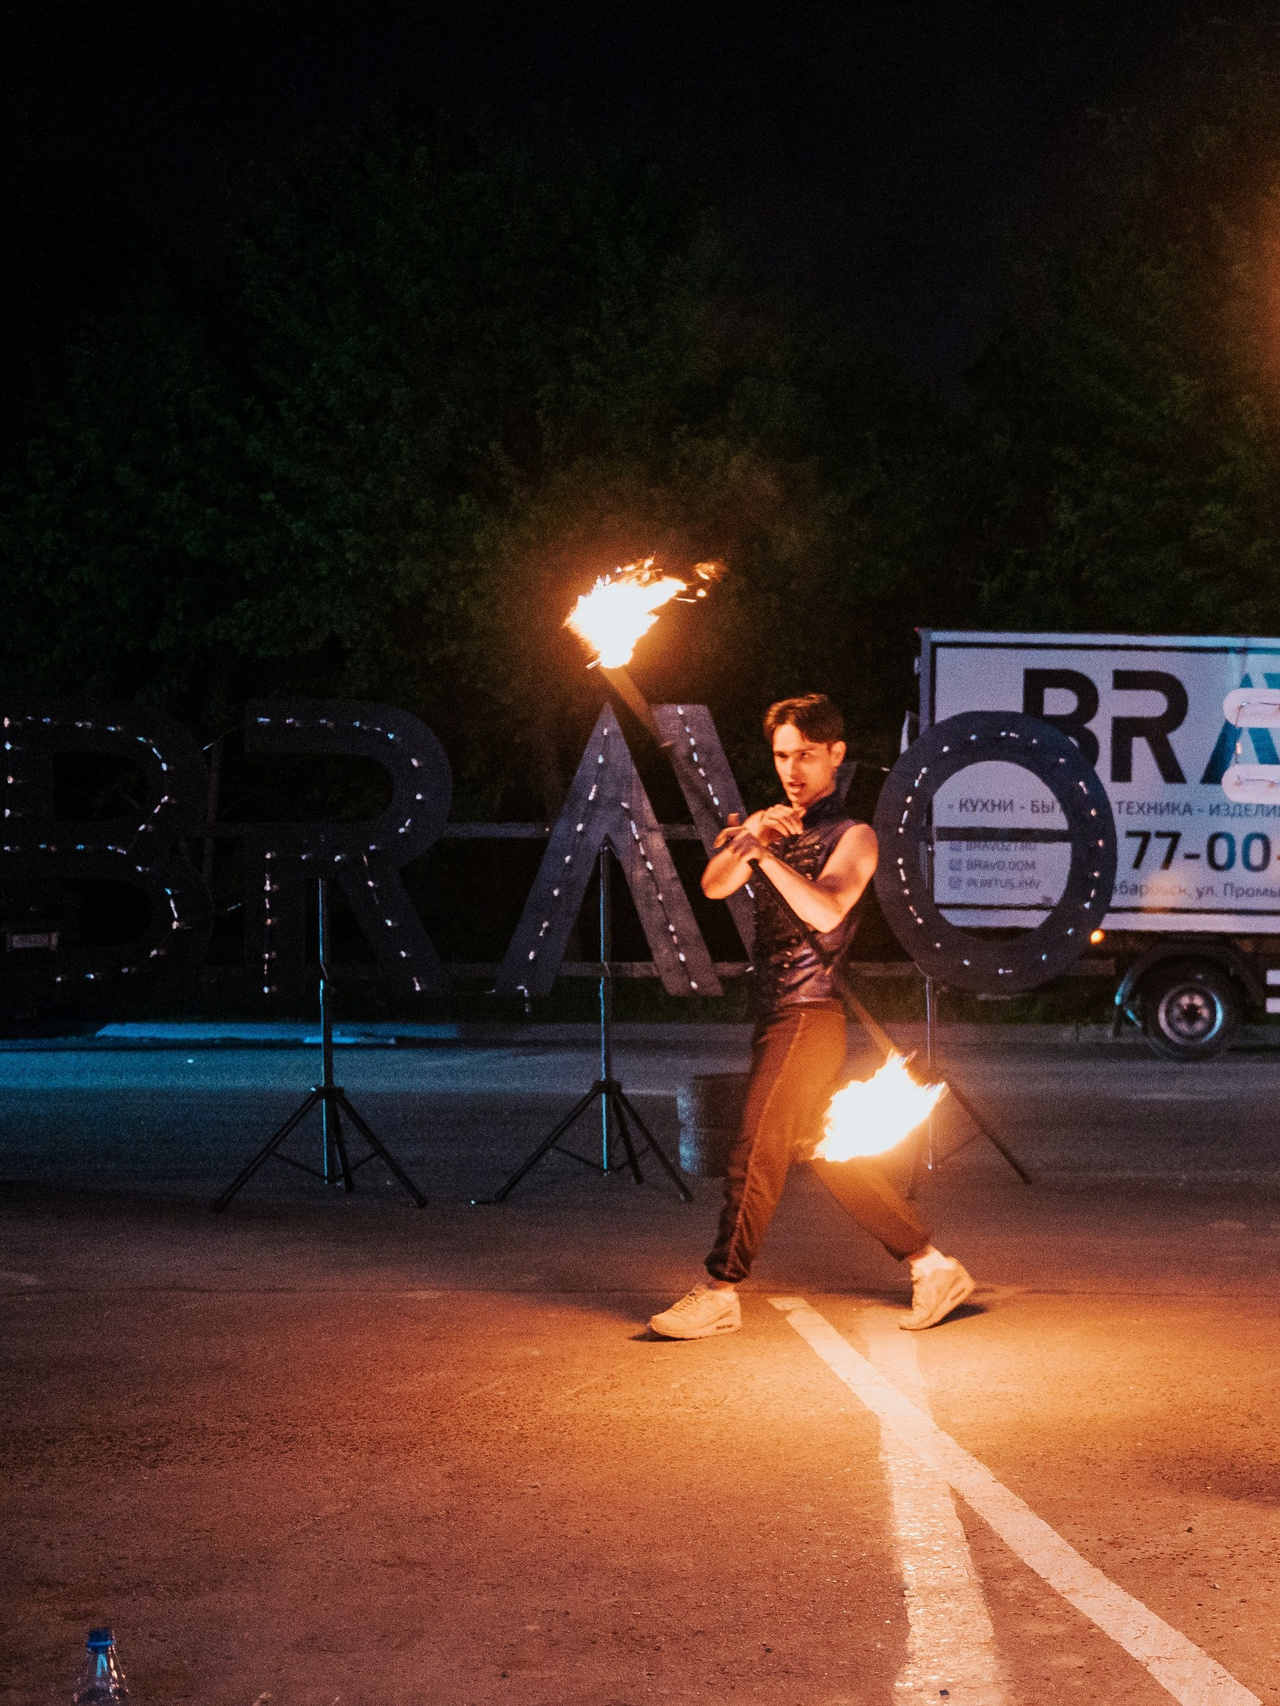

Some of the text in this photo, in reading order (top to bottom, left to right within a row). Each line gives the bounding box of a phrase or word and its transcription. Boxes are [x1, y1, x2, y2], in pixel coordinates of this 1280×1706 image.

[958, 798, 1014, 814] КУХНИ
[1116, 800, 1193, 817] ТЕХНИКА
[1195, 885, 1218, 901] ул.
